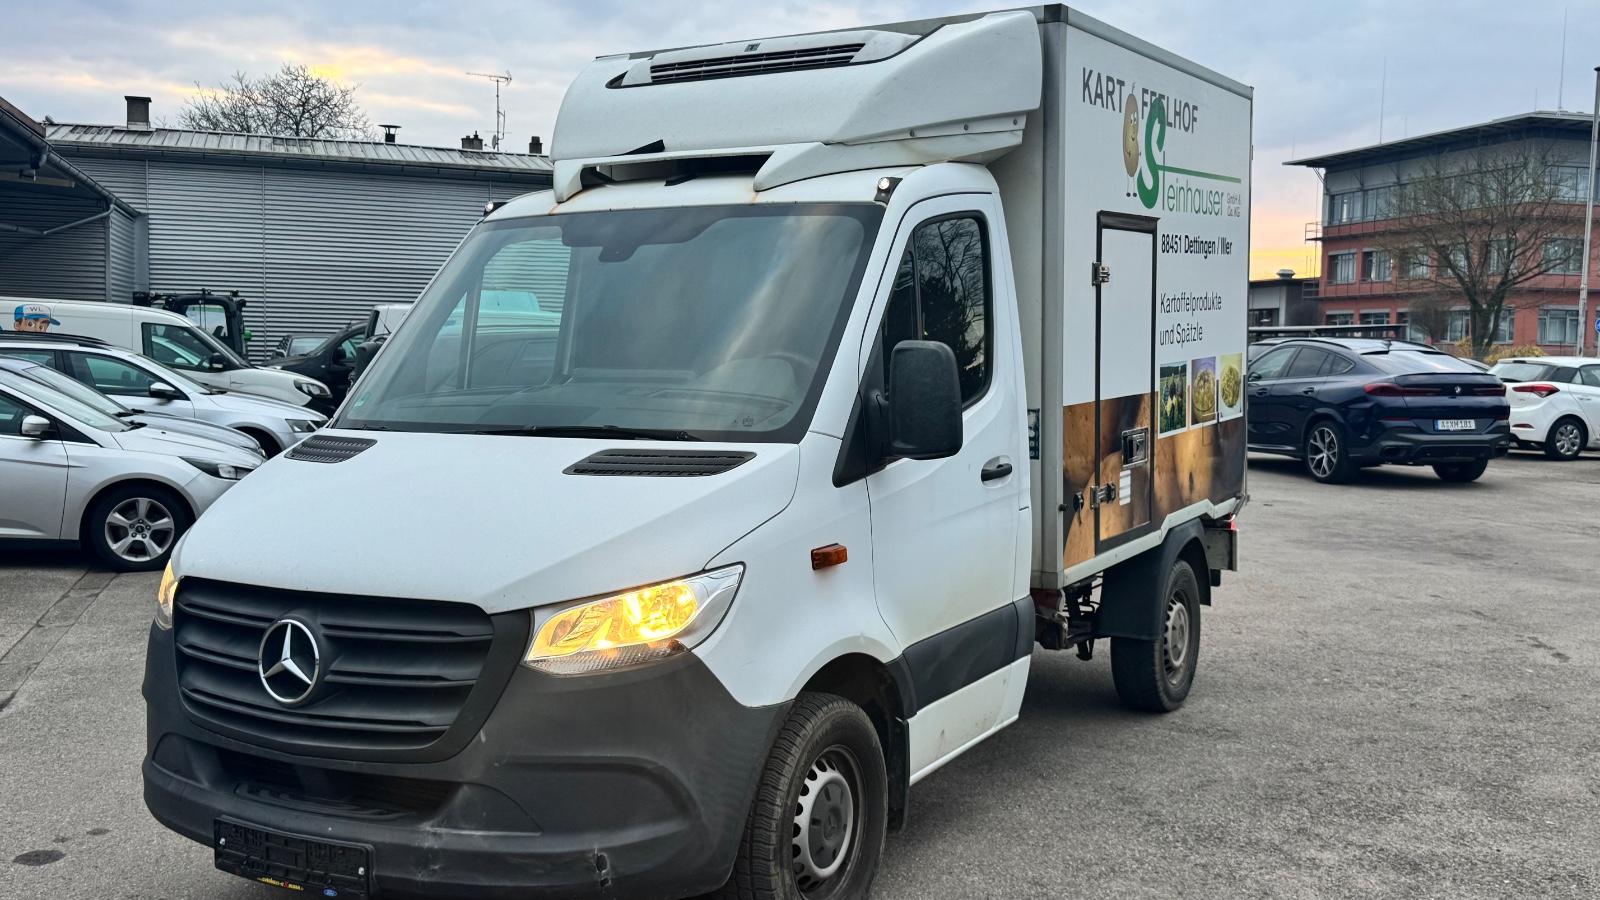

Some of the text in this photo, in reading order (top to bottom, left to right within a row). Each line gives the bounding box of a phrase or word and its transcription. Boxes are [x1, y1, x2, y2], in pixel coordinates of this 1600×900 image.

[1161, 233, 1182, 254] 88451
[1184, 234, 1216, 259] Dettingen
[1221, 237, 1232, 255] Iller
[1160, 291, 1222, 316] Kartoffelprodukte
[1160, 322, 1203, 348] und Spätzle
